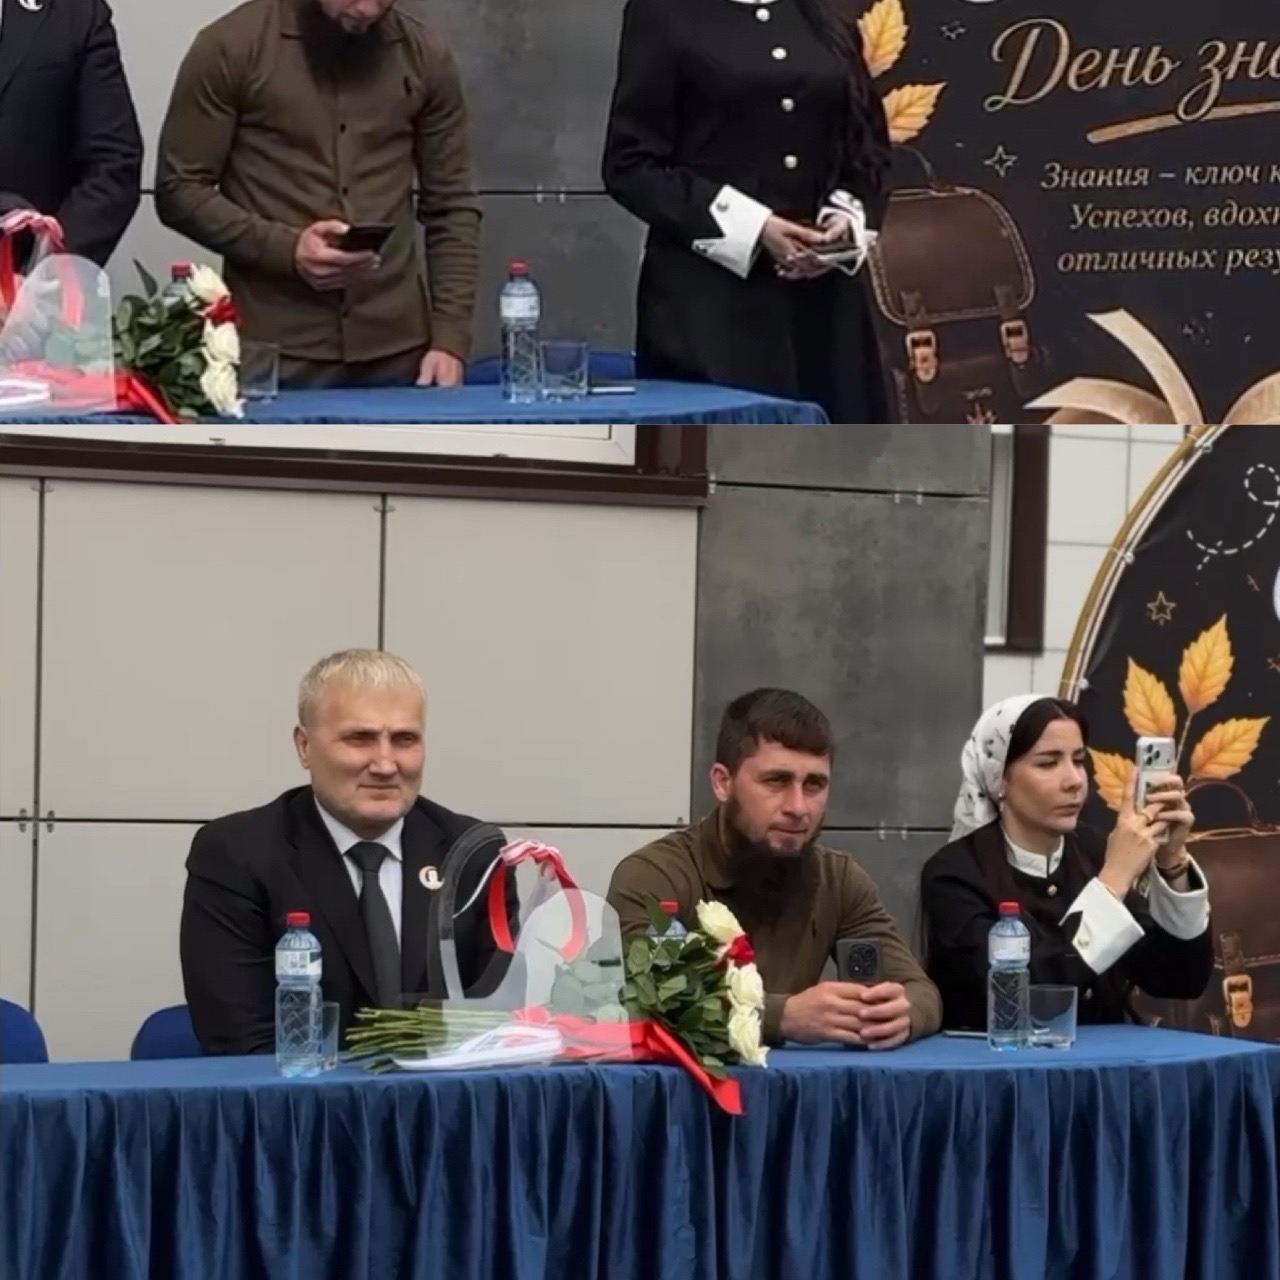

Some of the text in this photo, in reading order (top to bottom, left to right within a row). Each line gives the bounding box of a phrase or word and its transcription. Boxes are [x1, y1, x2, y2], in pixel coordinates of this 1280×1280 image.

[983, 18, 1182, 113] День
[1040, 162, 1151, 189] Знания
[1184, 164, 1261, 186] ключ
[1070, 203, 1195, 231] Успехов,
[1057, 248, 1218, 273] отличных
